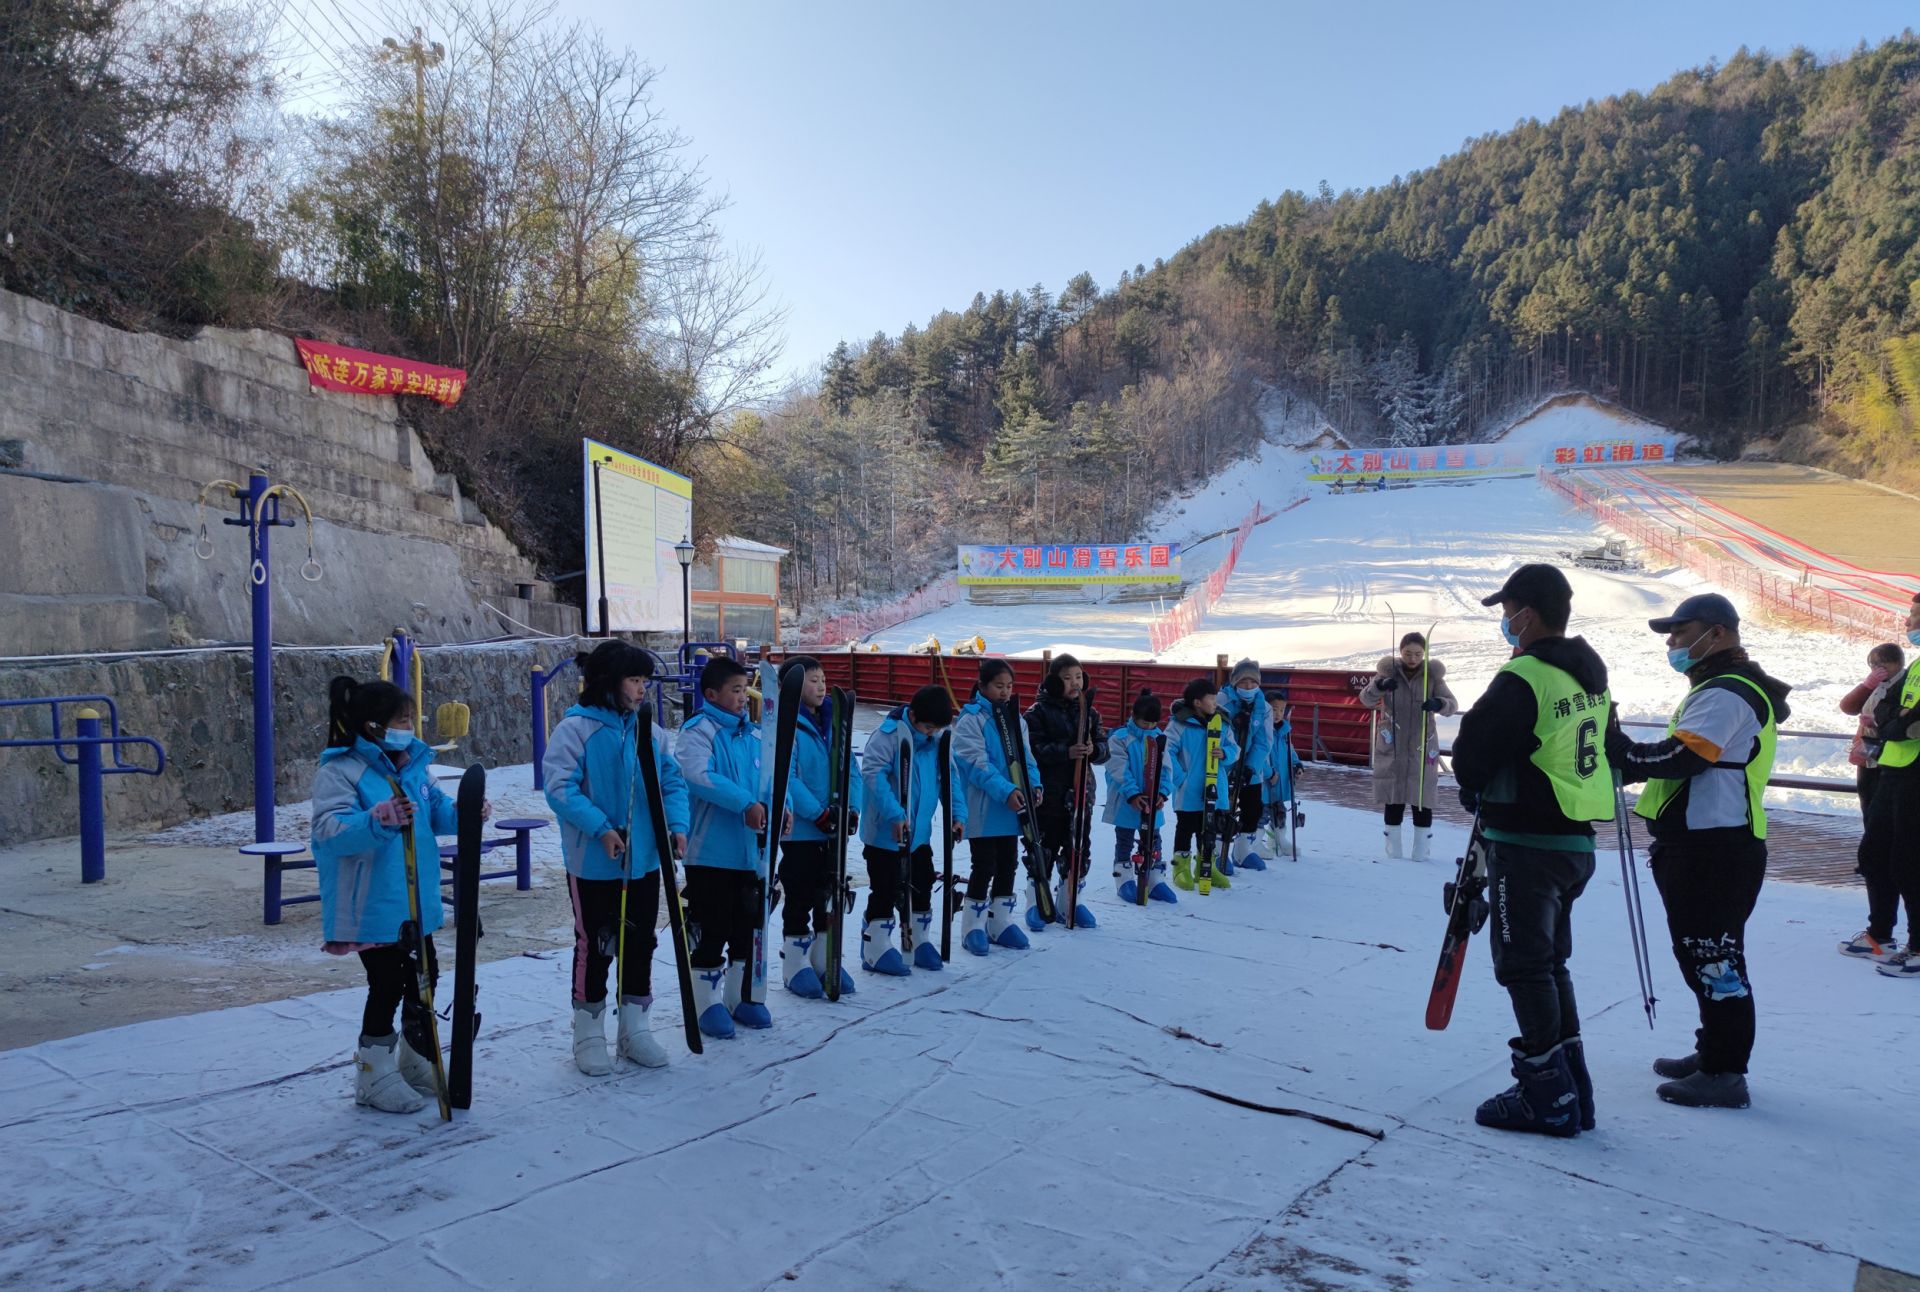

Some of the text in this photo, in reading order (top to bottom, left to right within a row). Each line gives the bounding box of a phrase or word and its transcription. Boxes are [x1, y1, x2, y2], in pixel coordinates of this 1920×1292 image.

[1554, 443, 1665, 464] 彩虹滑道
[998, 545, 1171, 569] 大别山滑雪乐园
[1350, 675, 1372, 685] 小心
[1575, 716, 1599, 780] 6
[1498, 876, 1512, 943] TBROWNE
